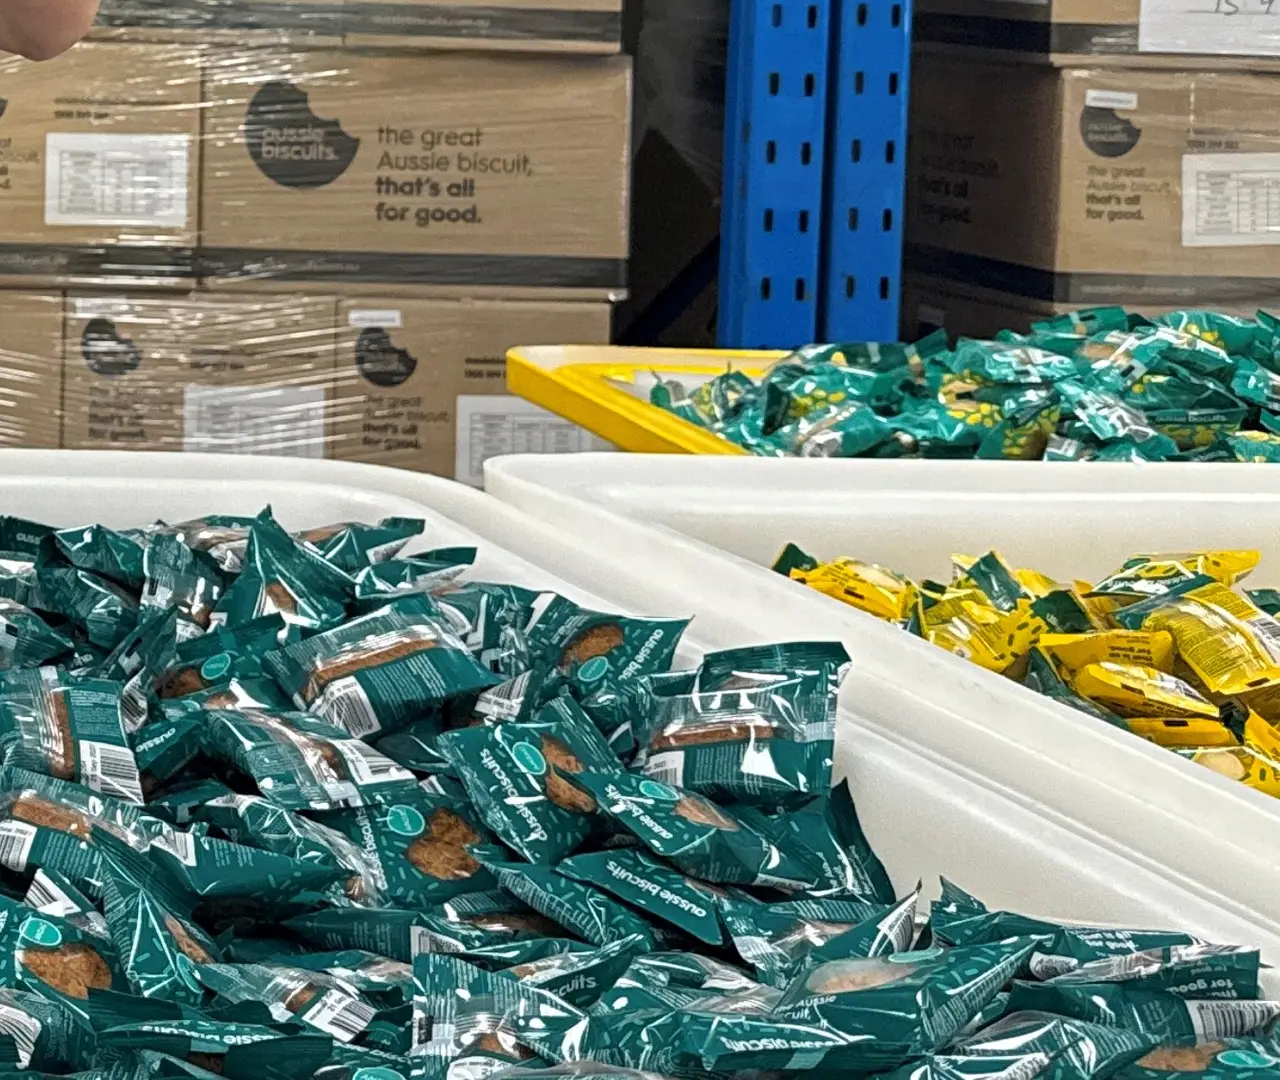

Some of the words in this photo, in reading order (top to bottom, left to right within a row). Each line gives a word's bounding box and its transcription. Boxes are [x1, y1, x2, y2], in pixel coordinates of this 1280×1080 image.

[261, 124, 325, 144] aussie
[378, 125, 415, 146] the
[420, 126, 484, 151] great
[376, 152, 450, 172] Aussie
[457, 153, 534, 177] biscuit,
[375, 176, 441, 198] that's
[446, 178, 475, 198] all
[375, 202, 410, 223] for
[415, 203, 482, 228] good.
[634, 628, 665, 664] aussie
[605, 859, 660, 897] biscuits
[659, 890, 708, 918] aussie
